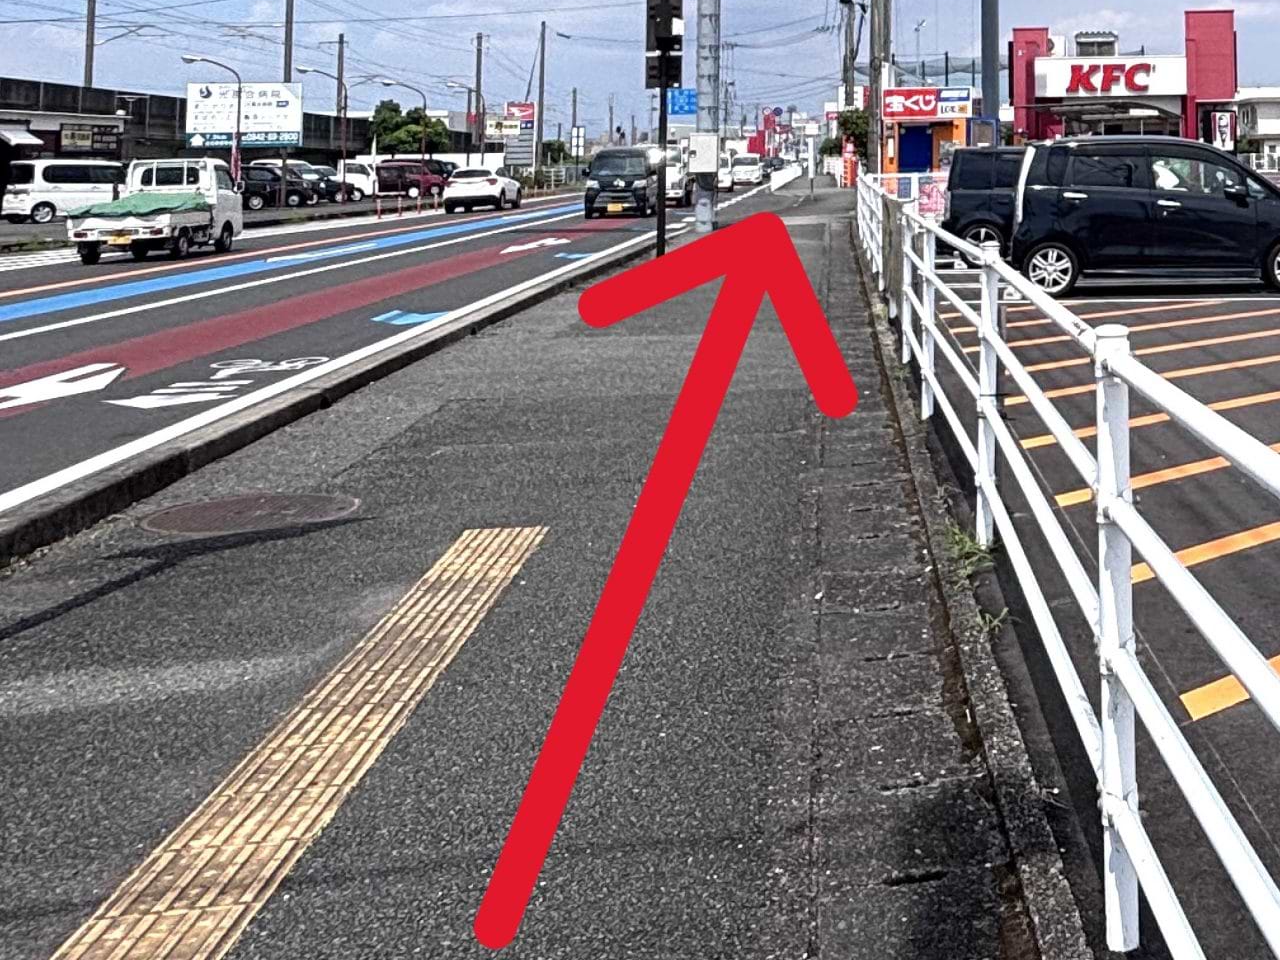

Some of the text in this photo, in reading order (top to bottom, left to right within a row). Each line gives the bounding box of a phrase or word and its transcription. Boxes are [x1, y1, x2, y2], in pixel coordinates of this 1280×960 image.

[1066, 63, 1152, 94] KFC
[885, 94, 937, 113] 宝くじ
